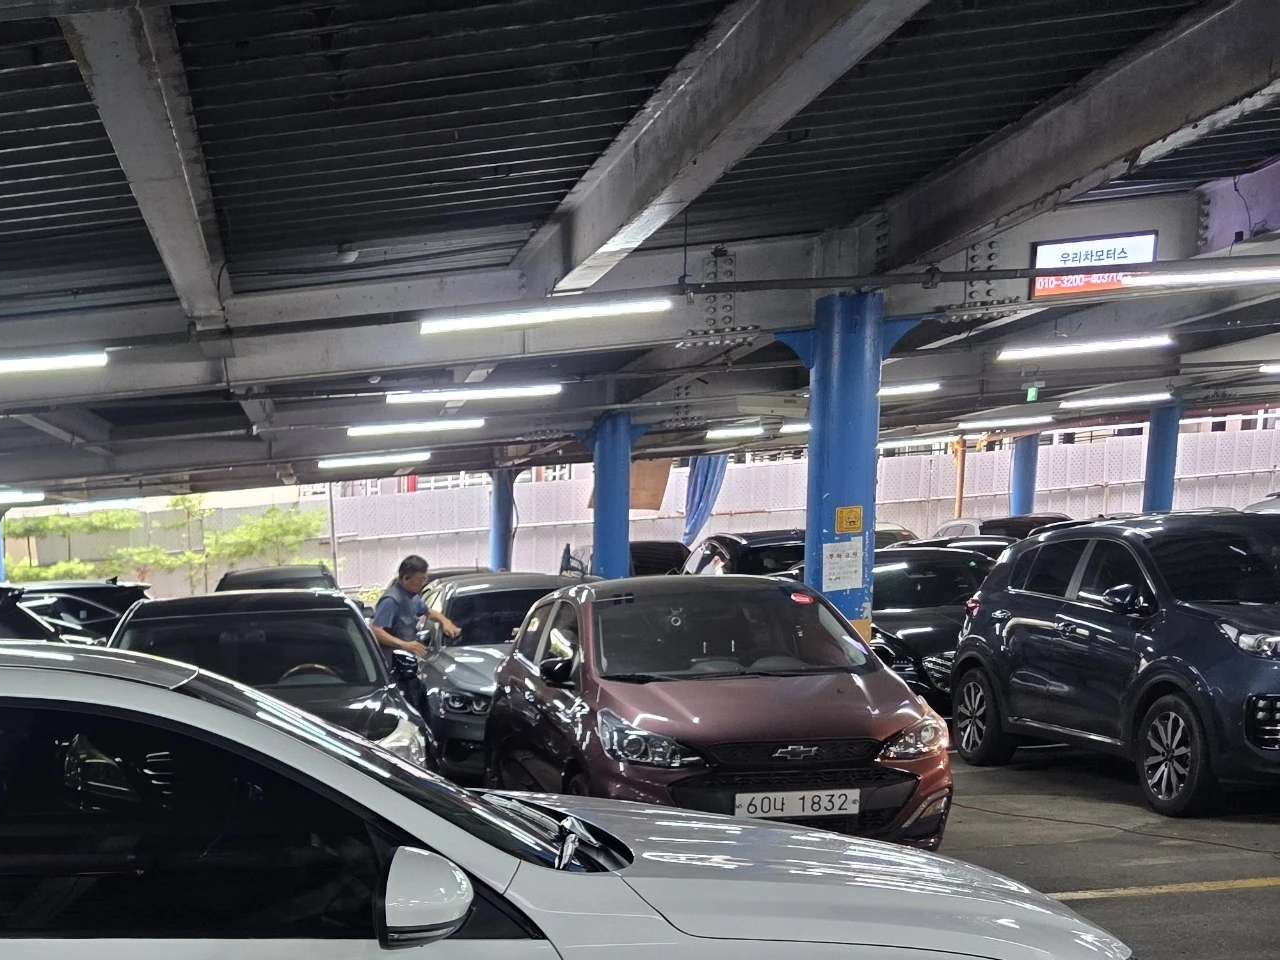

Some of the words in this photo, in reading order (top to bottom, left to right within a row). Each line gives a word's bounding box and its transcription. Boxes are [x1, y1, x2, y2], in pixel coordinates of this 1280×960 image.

[1060, 247, 1128, 265] 우리차모터스
[747, 796, 785, 814] 60나
[799, 794, 848, 812] 1832
